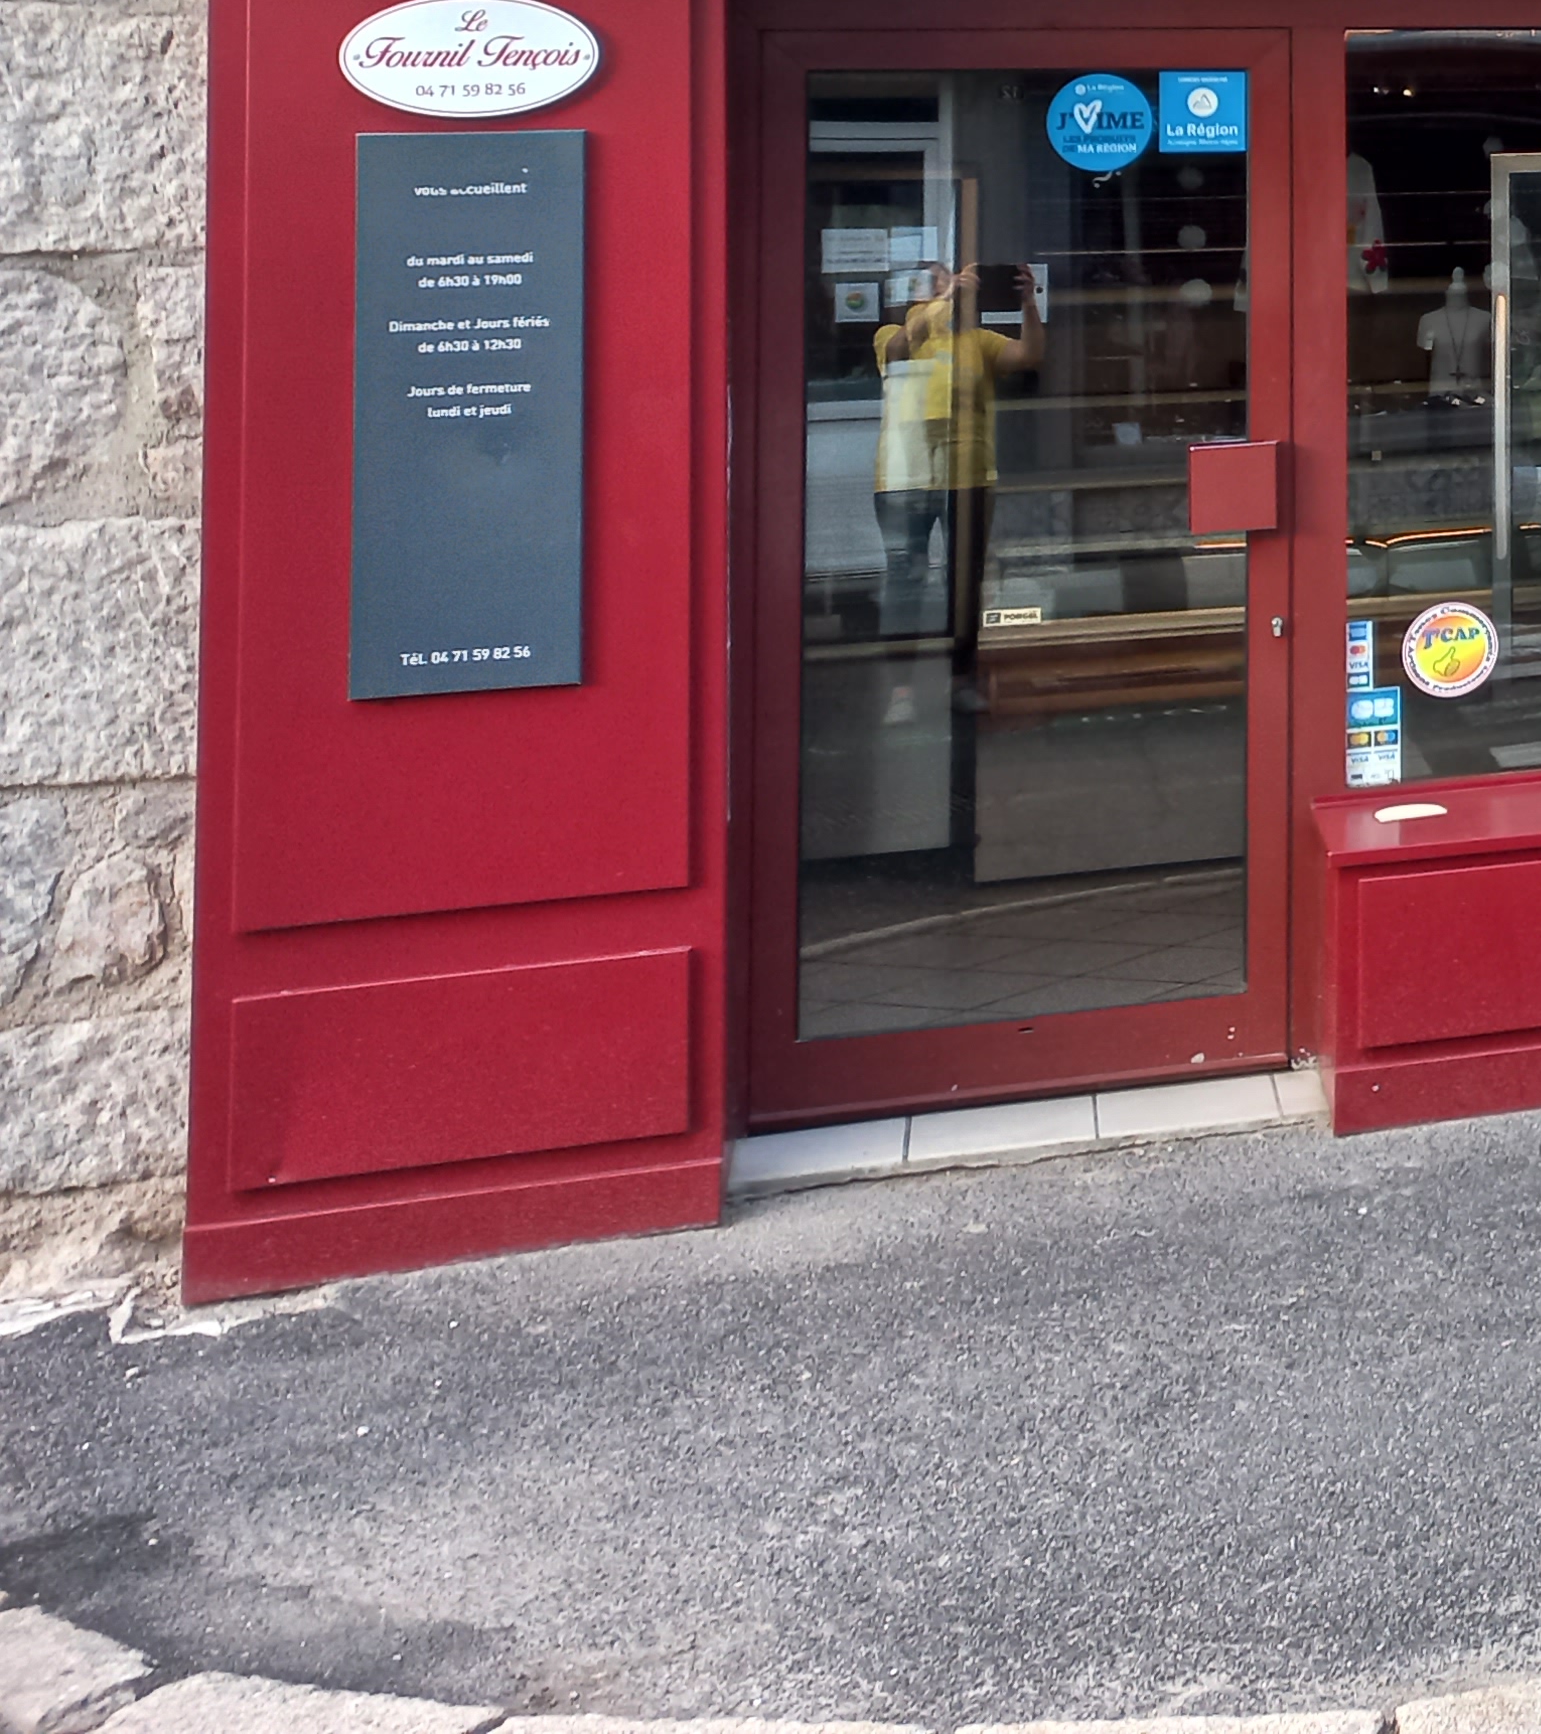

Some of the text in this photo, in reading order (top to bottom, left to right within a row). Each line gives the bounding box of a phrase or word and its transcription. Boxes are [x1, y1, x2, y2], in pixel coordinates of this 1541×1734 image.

[454, 9, 488, 32] Le
[358, 35, 581, 70] Fournil Tençois
[415, 82, 526, 97] 04 71 59 82 56
[1166, 123, 1238, 138] La Région
[406, 251, 534, 267] du mardi au samedi
[418, 274, 522, 288] de 6h30 à 19h00
[388, 316, 550, 333] Dimanche et Jours fériés
[418, 338, 522, 353] de 6h30 à 12h30
[406, 382, 532, 398] Jours de fermeture
[427, 403, 512, 418] lundi et jeudi
[430, 652, 449, 664] 04
[452, 650, 468, 662] 71
[472, 648, 490, 661] 59
[493, 647, 510, 659] 82
[513, 646, 531, 658] 56
